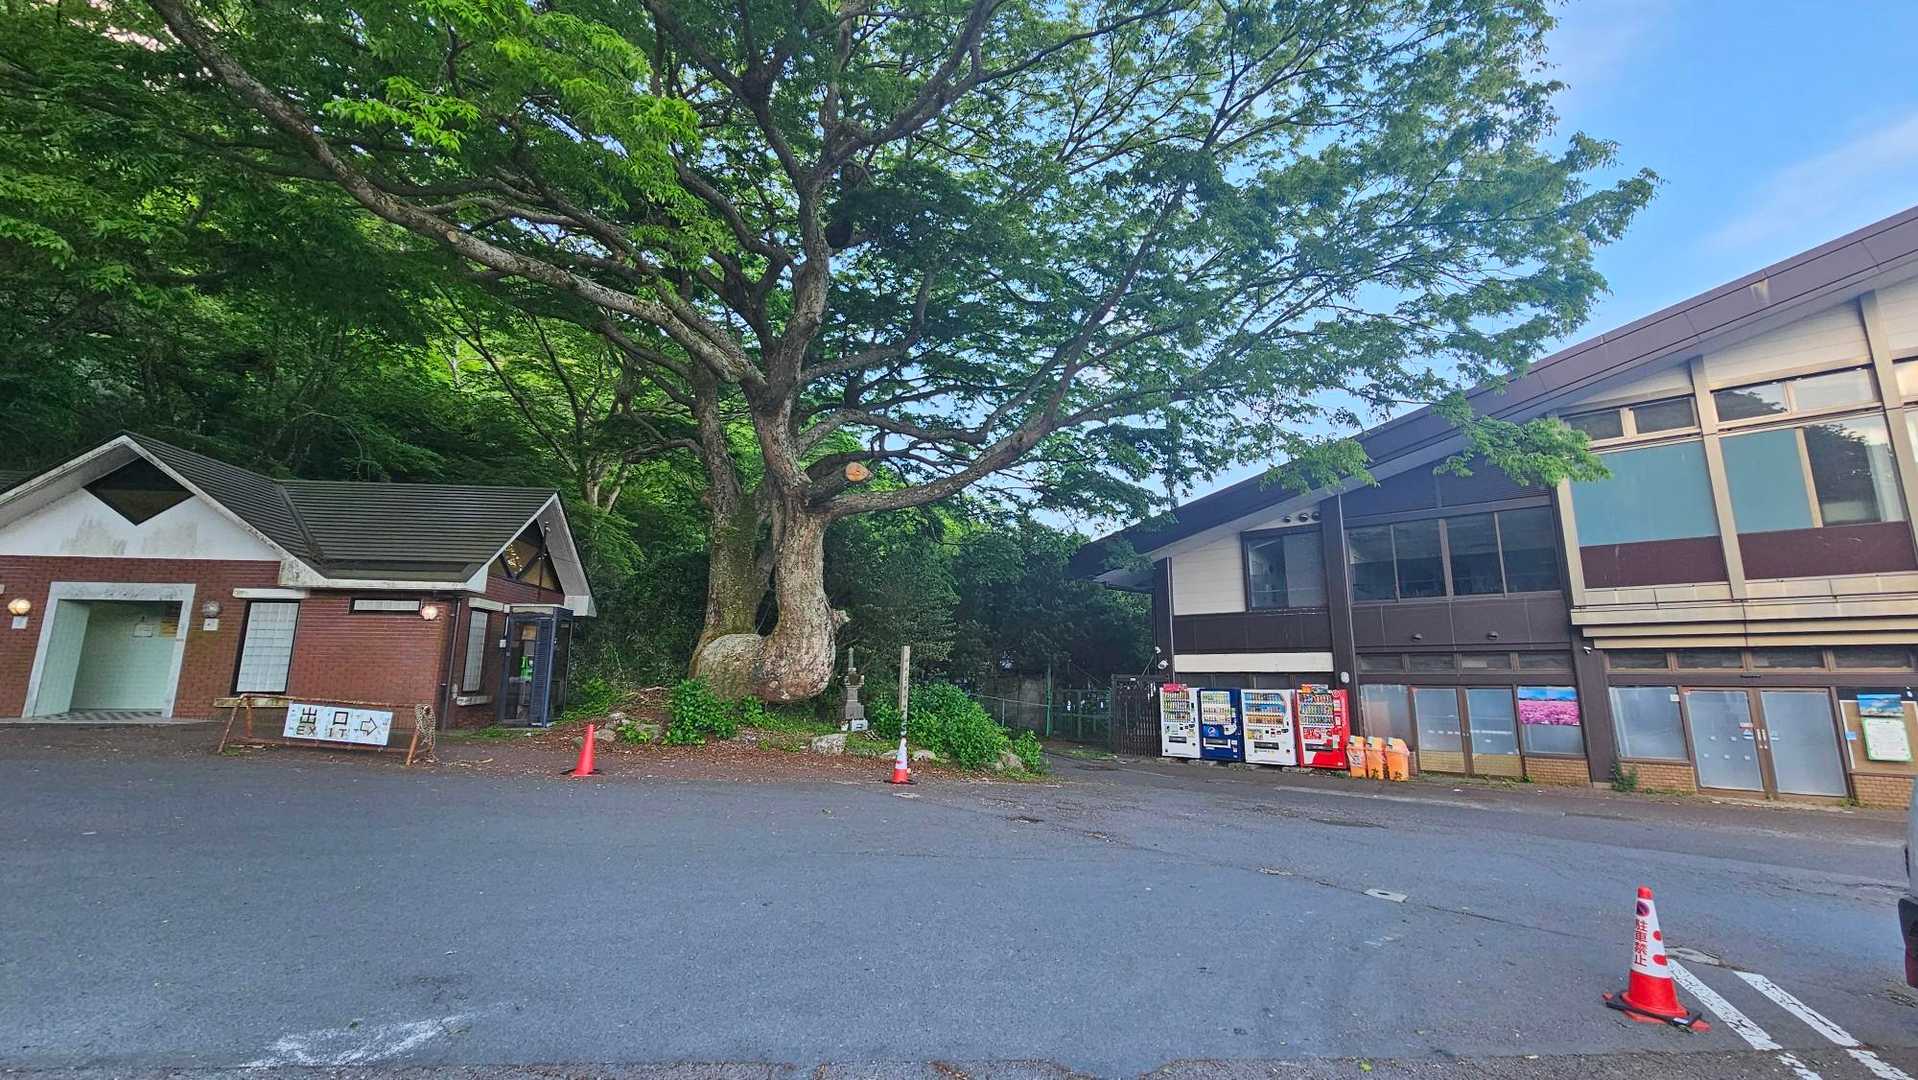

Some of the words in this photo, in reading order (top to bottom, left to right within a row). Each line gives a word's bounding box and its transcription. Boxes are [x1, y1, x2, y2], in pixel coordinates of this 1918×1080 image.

[300, 707, 348, 725] 出口
[1634, 918, 1648, 967] 駐車禁止
